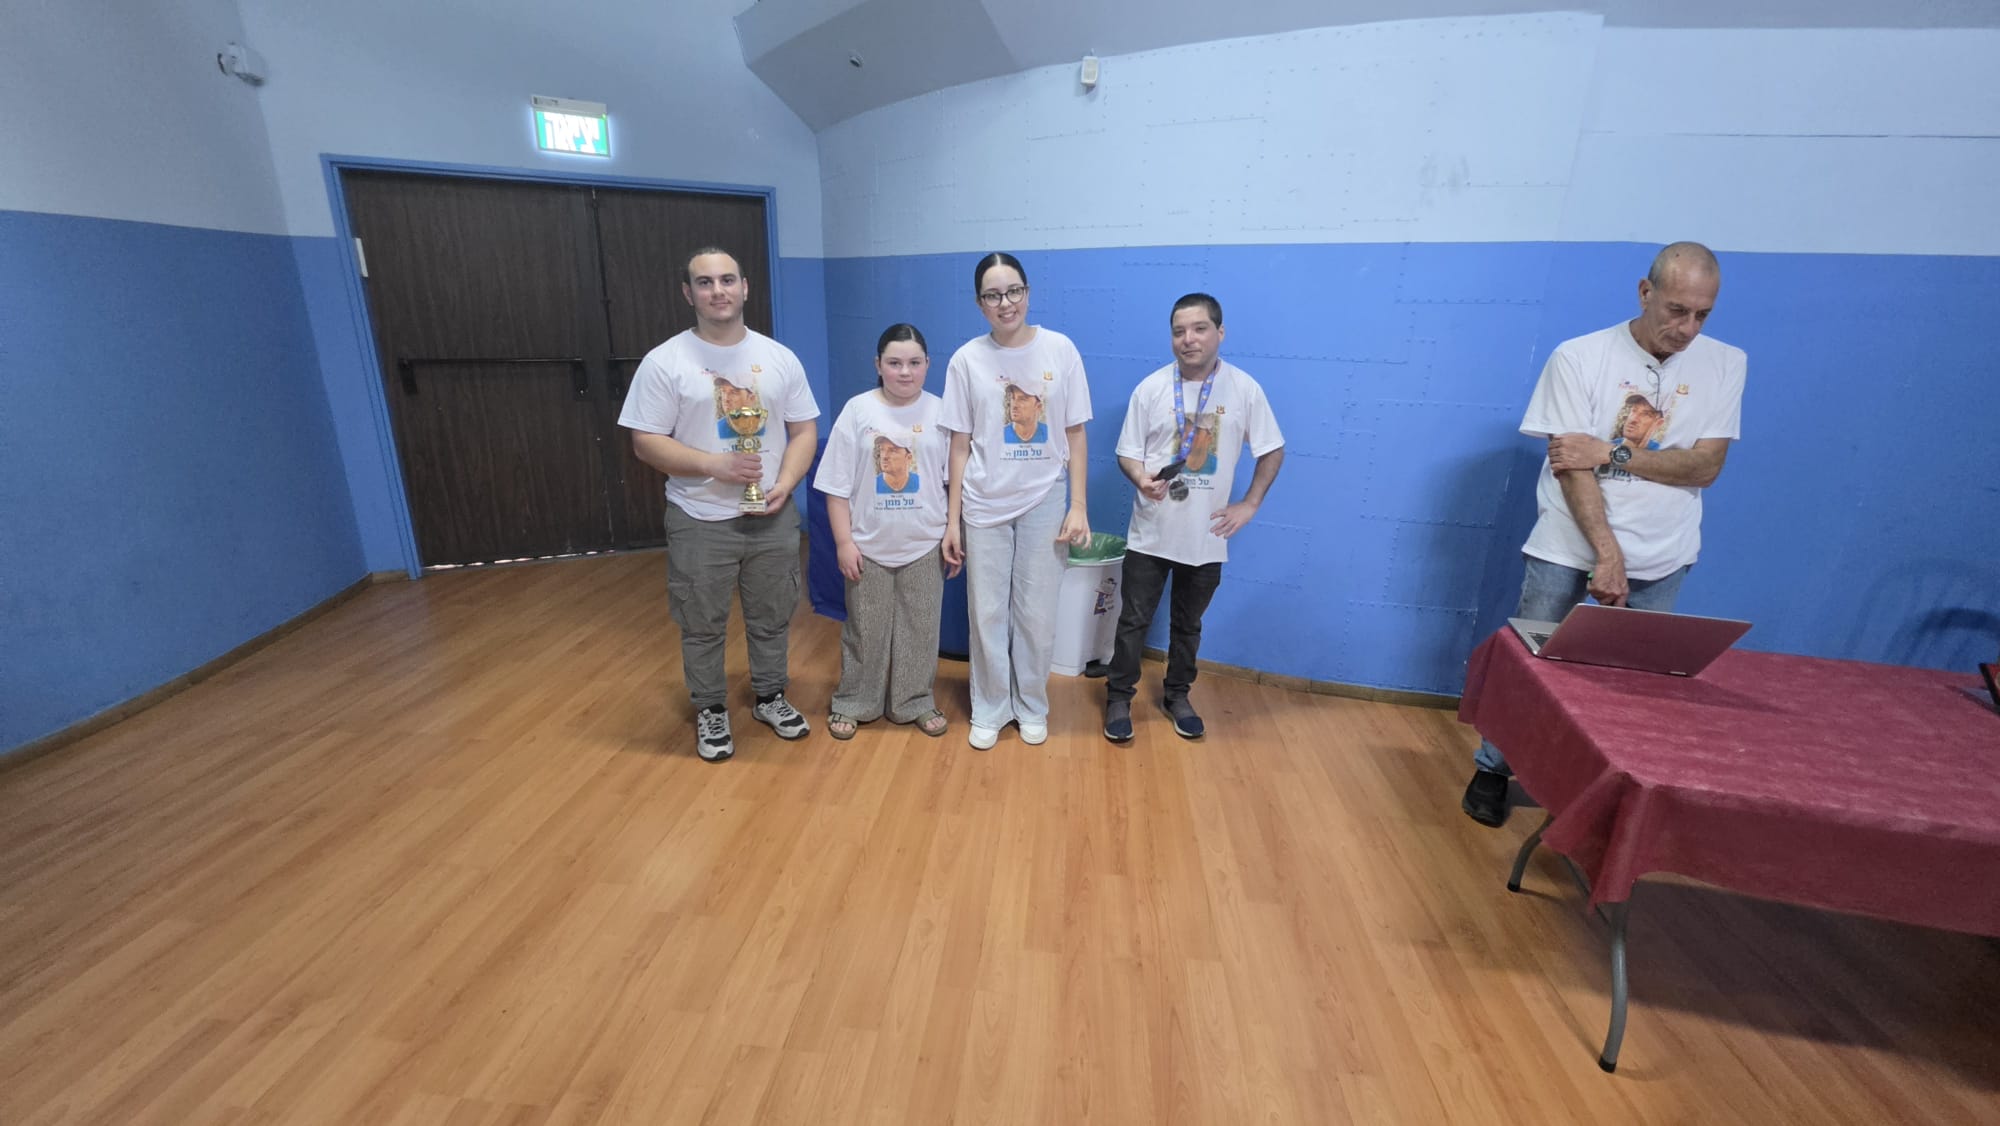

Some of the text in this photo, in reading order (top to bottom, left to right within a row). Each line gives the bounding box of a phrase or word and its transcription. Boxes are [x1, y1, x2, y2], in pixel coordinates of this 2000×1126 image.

[1030, 447, 1042, 456] טל
[885, 499, 901, 509] ממן
[902, 497, 914, 506] טל
